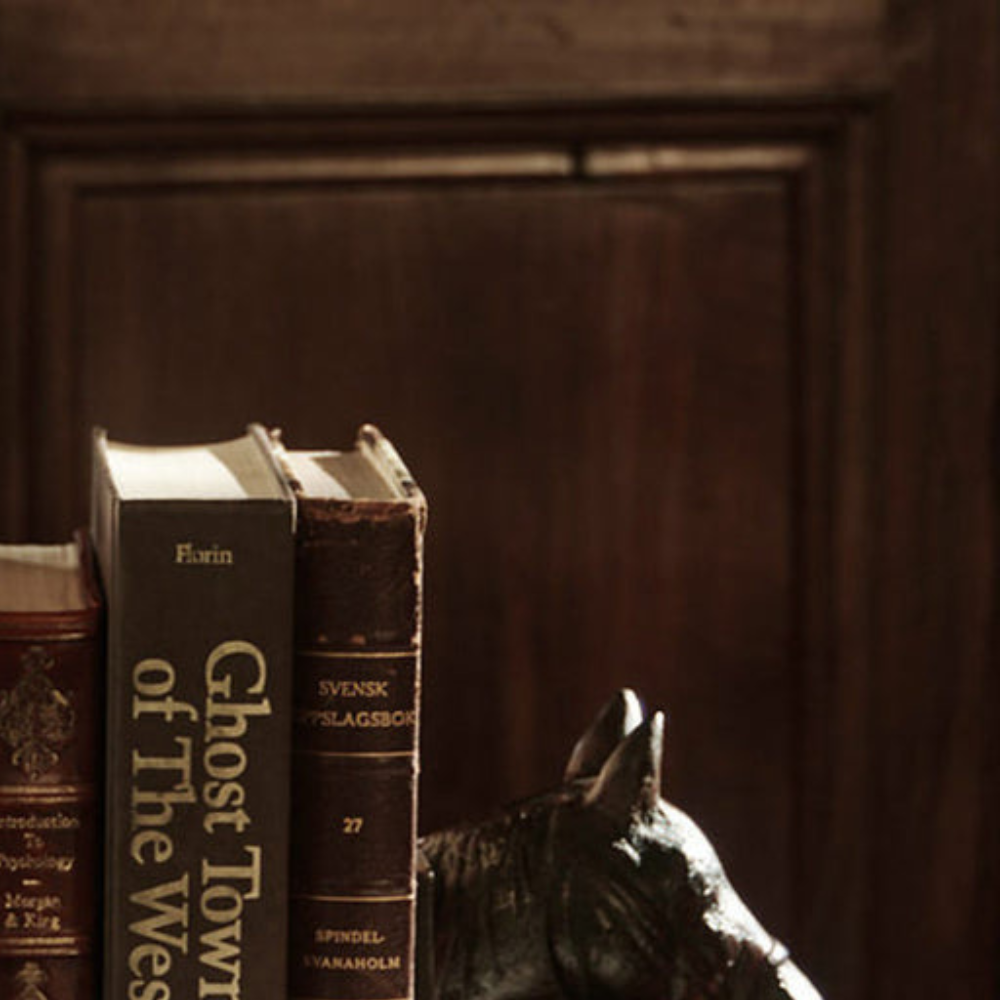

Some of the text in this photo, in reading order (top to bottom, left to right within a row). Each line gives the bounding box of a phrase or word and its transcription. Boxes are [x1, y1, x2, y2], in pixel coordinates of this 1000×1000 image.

[175, 543, 234, 564] Florin
[132, 657, 198, 722] of
[318, 680, 389, 697] SVENSK
[202, 639, 272, 834] Ghost
[130, 735, 197, 866] The
[342, 817, 364, 834] 27
